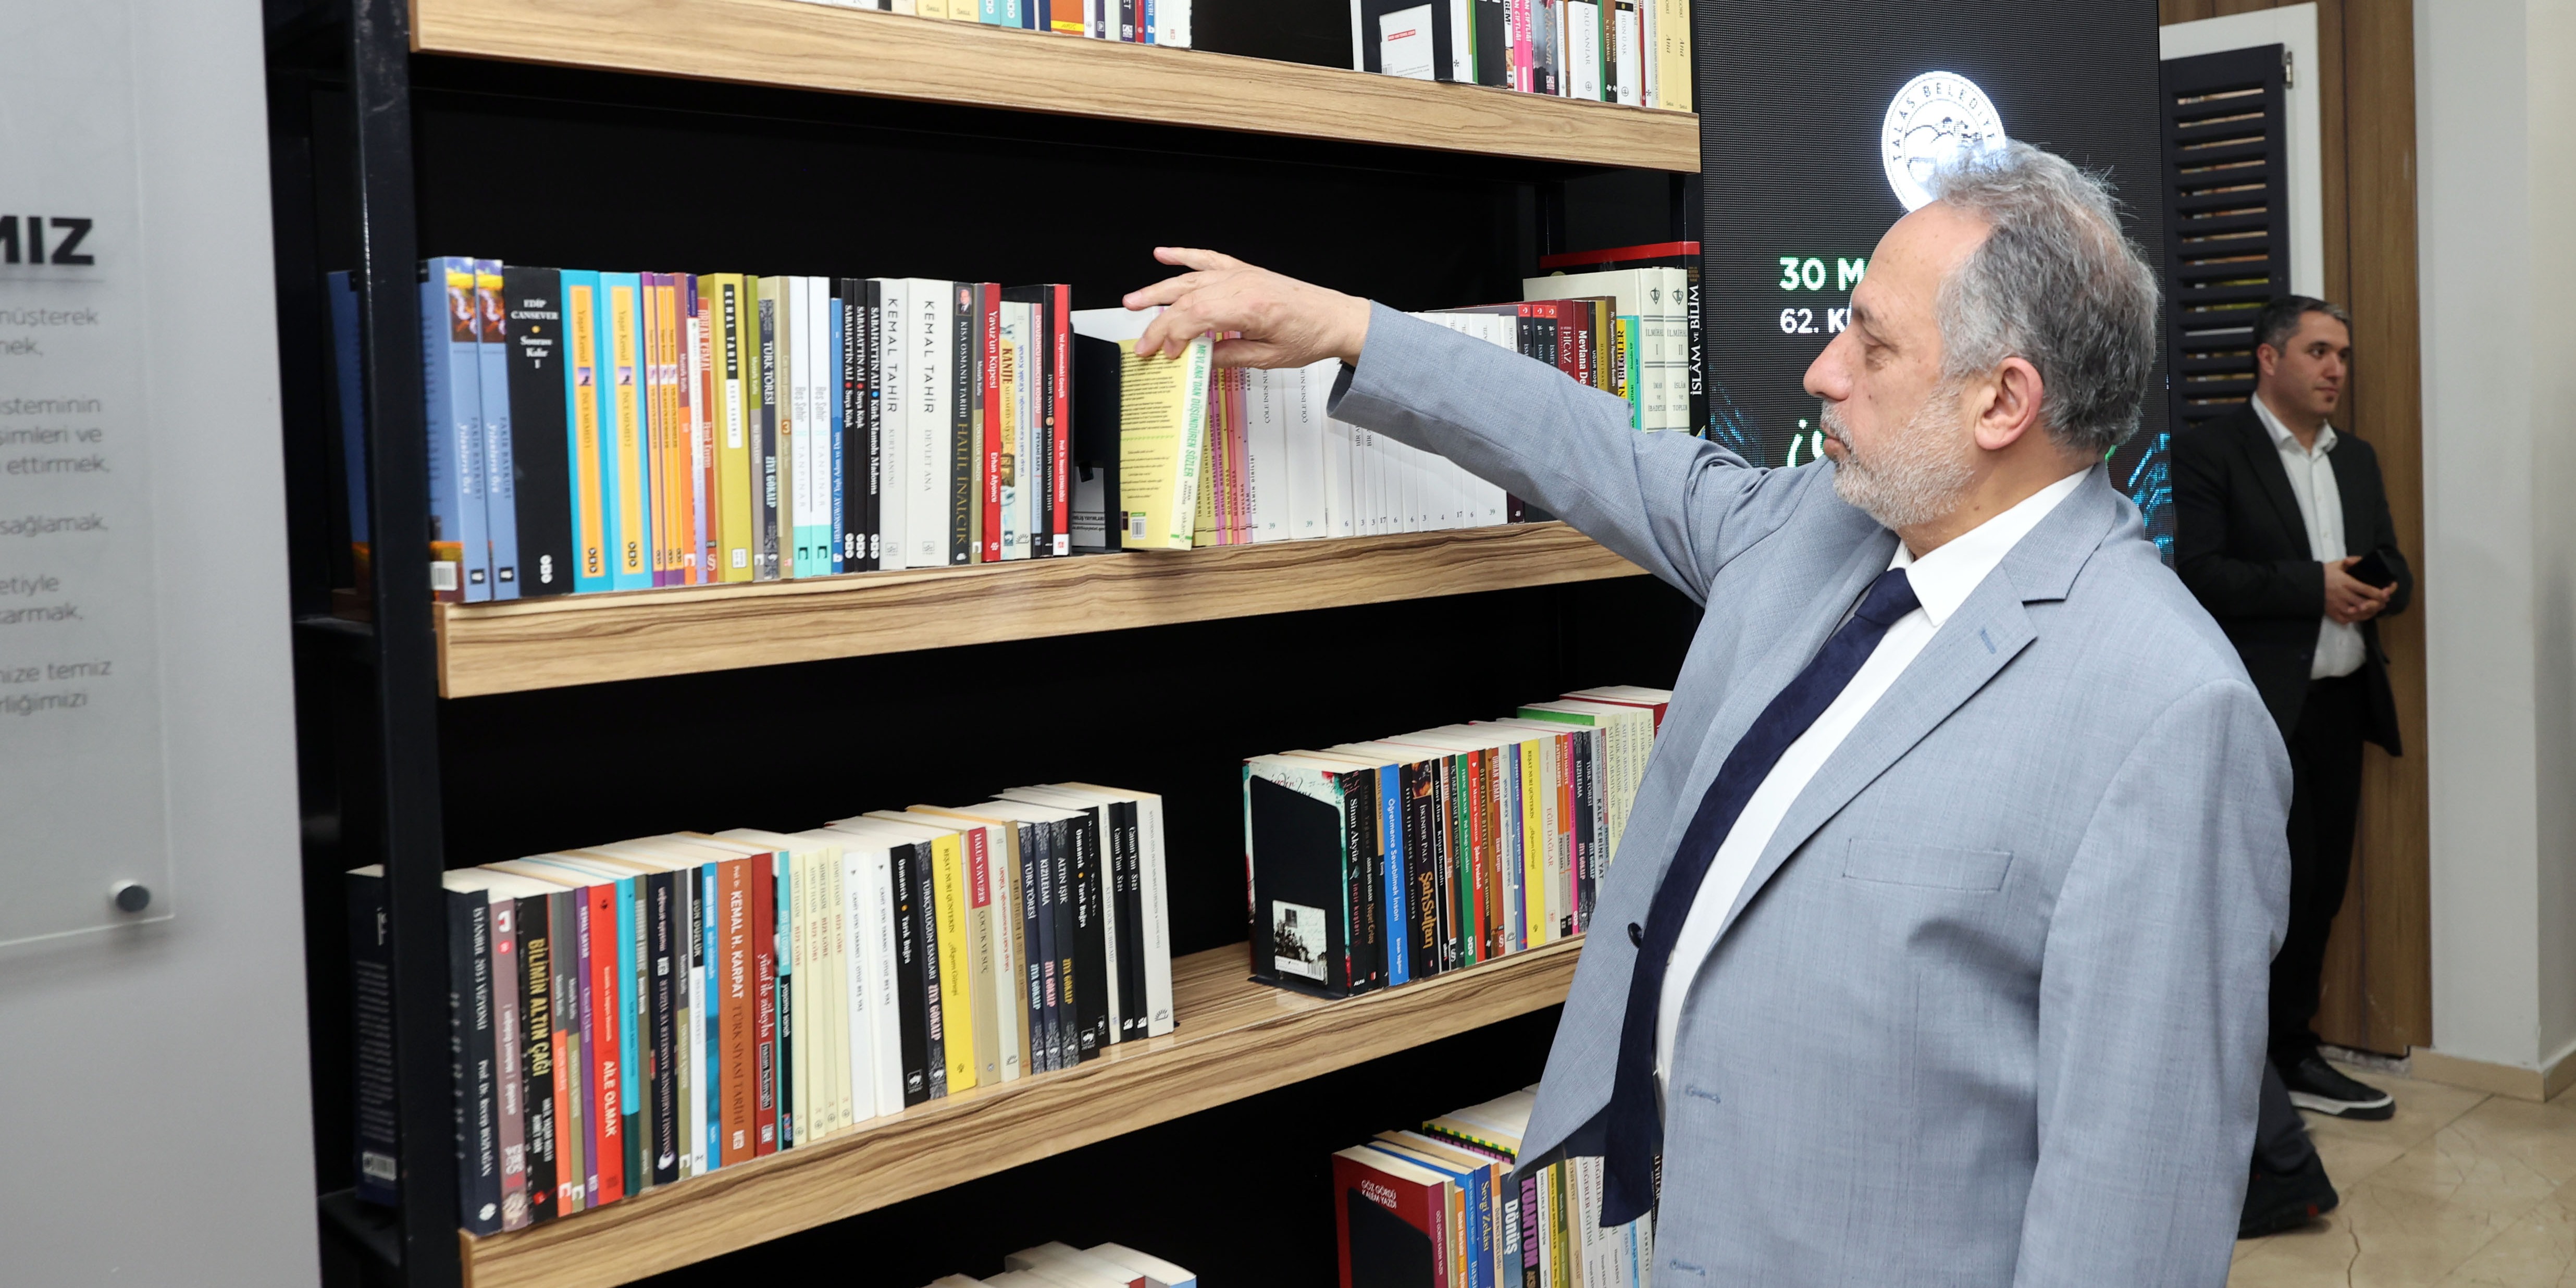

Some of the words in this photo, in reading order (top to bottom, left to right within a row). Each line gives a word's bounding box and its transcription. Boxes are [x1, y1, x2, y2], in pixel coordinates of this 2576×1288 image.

[1892, 97, 1915, 161] TALAS
[1779, 257, 1826, 291] 30
[511, 310, 559, 320] CANSEVER
[1688, 284, 1700, 330] BİLİM
[1780, 308, 1819, 333] 62.
[844, 304, 853, 364] SABAHATTİN
[857, 305, 865, 365] SABAHATTİN
[871, 307, 880, 370] SABAHATTİN
[887, 298, 898, 356] KEMAL
[924, 300, 935, 358] KEMAL
[988, 311, 998, 354] Yavuz'un
[1645, 327, 1664, 337] İLMİHAL
[1667, 327, 1688, 337] İLMİHAL
[1693, 332, 1699, 342] VE
[763, 341, 773, 369] TÜRK
[959, 342, 968, 382] OSMANLI
[1578, 330, 1588, 370] Mevlana
[1678, 344, 1683, 355] II
[764, 370, 775, 405] TÖRESİ
[845, 365, 854, 381] ALİ
[857, 366, 866, 382] ALİ
[871, 371, 880, 390] ALİ
[988, 356, 997, 389] Küpesi
[1653, 381, 1663, 389] İMAN
[1674, 381, 1686, 389] İSLÂM
[1689, 344, 1702, 396] İSLÂM
[887, 364, 898, 413] TAHİR
[924, 365, 934, 414] TAHİR
[959, 383, 967, 418] TARİHİ
[871, 420, 879, 455] Mantolu
[1186, 396, 1202, 449] DÜŞÜNDÜREN
[766, 455, 775, 474] ZİYA
[958, 423, 969, 473] HALİL
[1183, 449, 1197, 478] SÖZLER
[766, 475, 777, 508] GÖKALP
[956, 475, 967, 546] İNALCIK
[1492, 756, 1501, 778] ORHAN
[1575, 760, 1584, 799] KIZILELMA
[1493, 779, 1502, 803] KEMAL
[1349, 798, 1359, 828] Sinan
[1386, 797, 1398, 848] Öğretmence
[1419, 804, 1428, 841] İSKENDER
[1545, 808, 1554, 828] EĞİL
[1596, 798, 1605, 823] KALK
[974, 833, 984, 863] HALUK
[1075, 828, 1085, 870] Osmancık
[1349, 831, 1360, 863] Akyüz
[1546, 830, 1555, 868] DAĞLAR
[1597, 826, 1606, 860] YERİNE
[897, 859, 909, 902] Osmancık
[975, 863, 986, 904] YAVUZER
[1024, 861, 1034, 888] TÜRK
[1040, 859, 1050, 906] KIZILELMA
[1058, 857, 1067, 885] ALTIN
[1390, 849, 1400, 896] Sevebilmek
[730, 890, 744, 934] KEMAL
[922, 879, 935, 944] TÜRKÇÜLÜĞÜN
[1026, 889, 1036, 920] TÖRESİ
[1058, 885, 1069, 905] IŞIK
[1392, 896, 1401, 922] İnsanı
[901, 915, 911, 939] Tarık
[1078, 905, 1087, 928] Buğra
[730, 935, 744, 949] H.
[901, 939, 912, 964] Buğra
[528, 938, 550, 995] BİLİMİN
[730, 950, 745, 999] KARPAT
[927, 944, 937, 980] ESASLARI
[927, 984, 940, 1006] ZİYA
[530, 996, 550, 1042] ALTIN
[733, 1004, 744, 1041] TÜRK
[929, 1005, 942, 1042] GÖKALP
[527, 1041, 553, 1077] ÇAĞI
[603, 1060, 617, 1089] AİLE
[732, 1042, 745, 1080] SİYASİ
[604, 1090, 617, 1138] OLMAK
[733, 1082, 745, 1125] TARİHİ
[1479, 1180, 1491, 1213] Sevgi
[1582, 1161, 1592, 1209] DEĞERLER
[1594, 1156, 1603, 1204] DEĞERLER
[1504, 1198, 1520, 1255] Dönüş
[1521, 1176, 1539, 1269] KUANTUM
[1584, 1209, 1594, 1247] EĞİTİMİ
